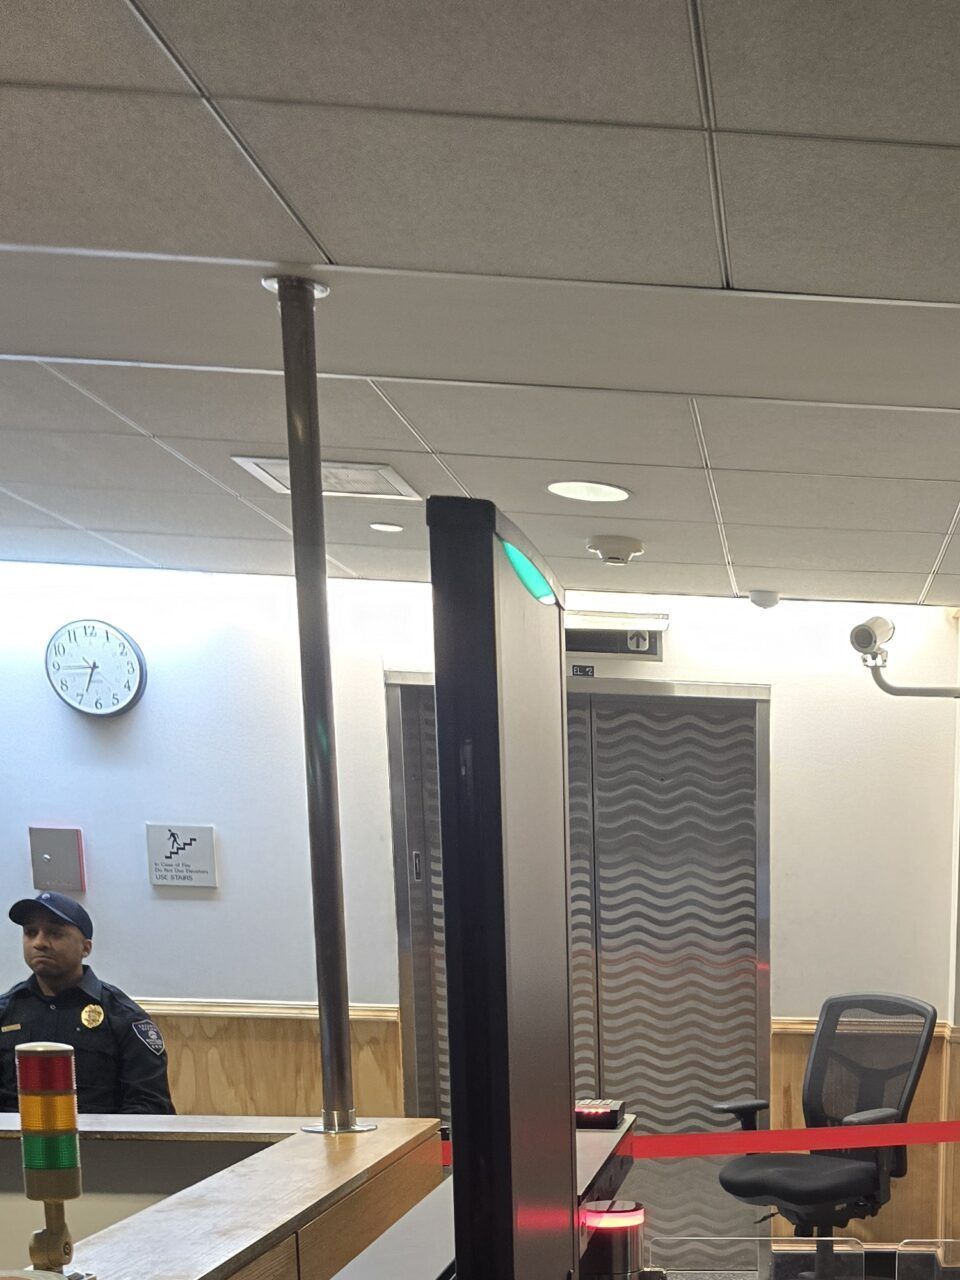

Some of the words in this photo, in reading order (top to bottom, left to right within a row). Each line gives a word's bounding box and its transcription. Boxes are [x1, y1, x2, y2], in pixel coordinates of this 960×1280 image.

[67, 629, 78, 645] 11
[83, 625, 97, 638] 12
[53, 642, 66, 657] 10
[118, 642, 128, 657] 2
[52, 660, 61, 671] 9
[126, 661, 135, 675] 3
[60, 679, 69, 692] 8
[123, 680, 131, 692] 4
[76, 692, 84, 705] 7
[94, 697, 103, 710] 6
[111, 693, 120, 706] 5
